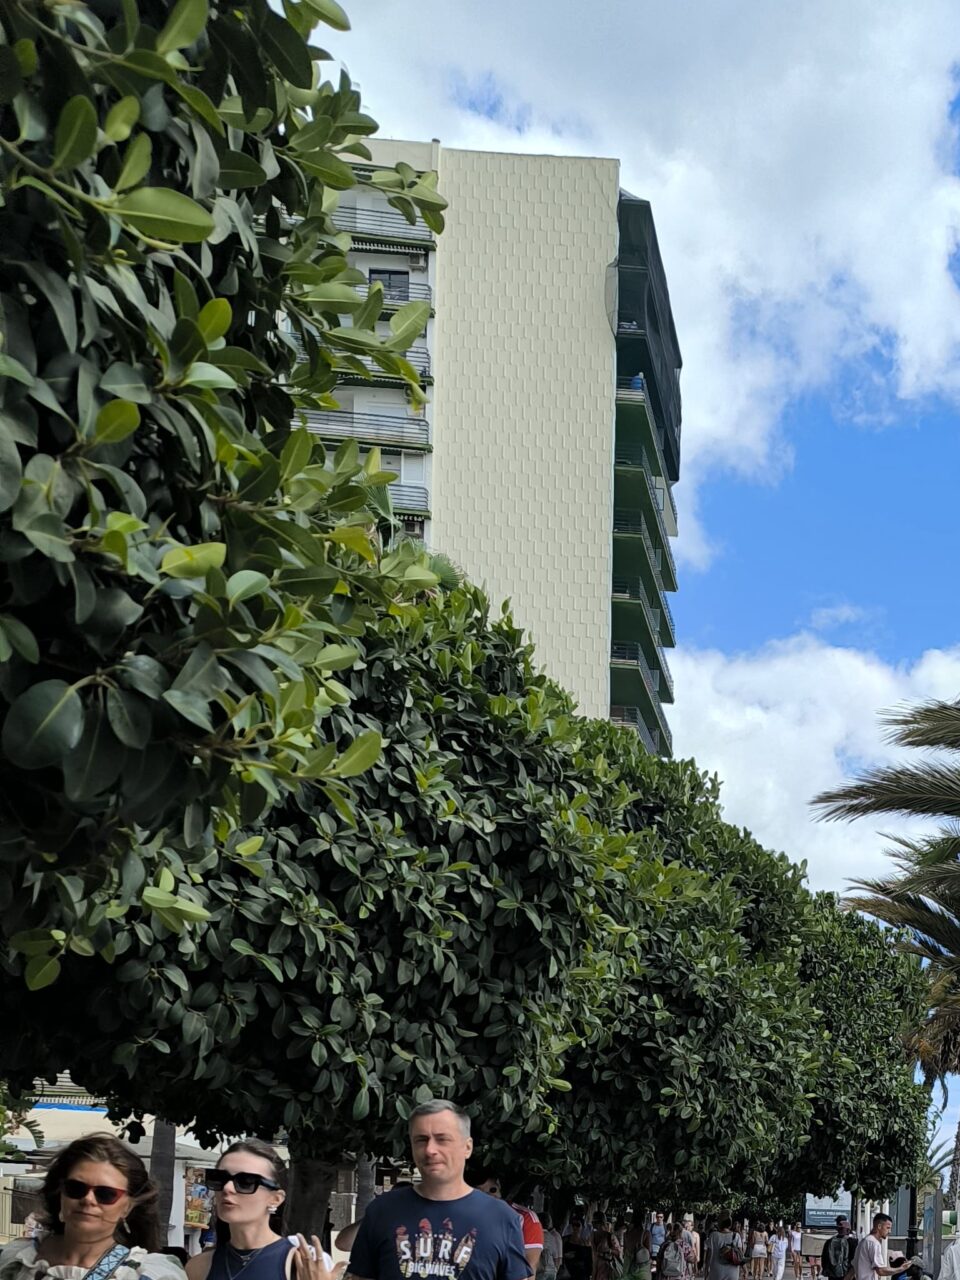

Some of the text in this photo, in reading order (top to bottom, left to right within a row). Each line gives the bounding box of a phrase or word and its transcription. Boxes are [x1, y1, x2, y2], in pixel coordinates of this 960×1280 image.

[400, 1237, 472, 1263] SURF
[408, 1261, 456, 1277] BIG WAVES
